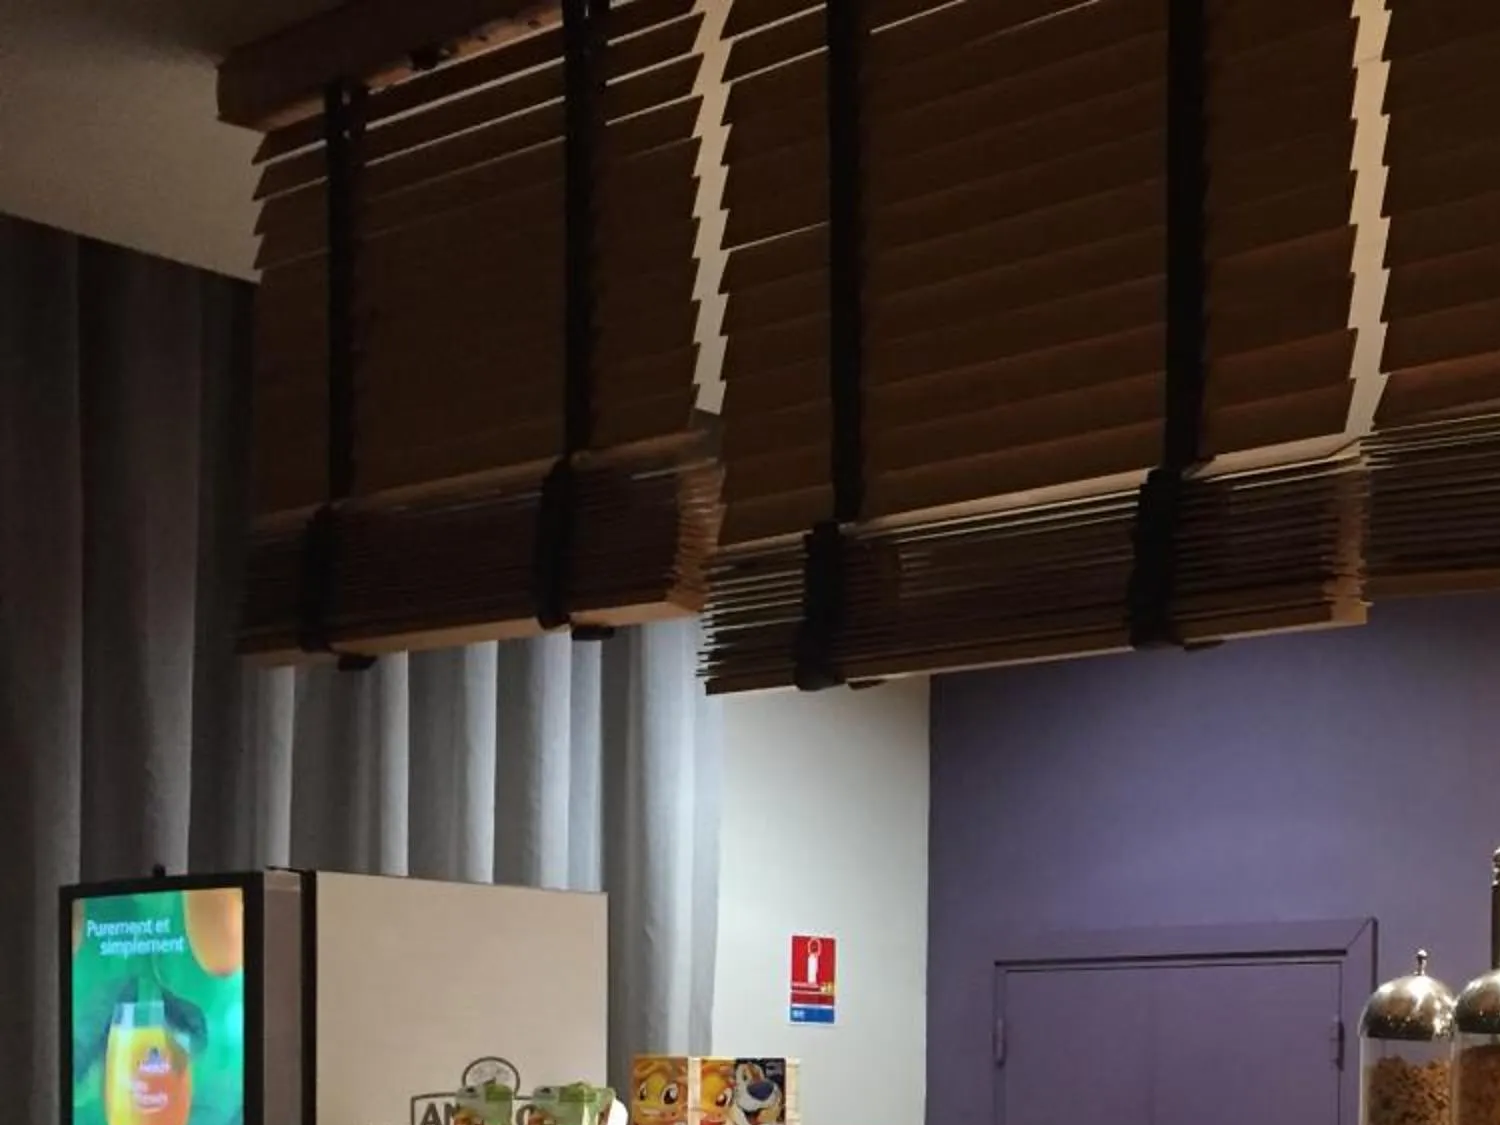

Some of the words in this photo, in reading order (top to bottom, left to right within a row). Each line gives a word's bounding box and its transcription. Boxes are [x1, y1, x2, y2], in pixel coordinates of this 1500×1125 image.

[86, 919, 152, 938] Purement
[155, 918, 170, 934] et
[100, 936, 184, 959] simplement
